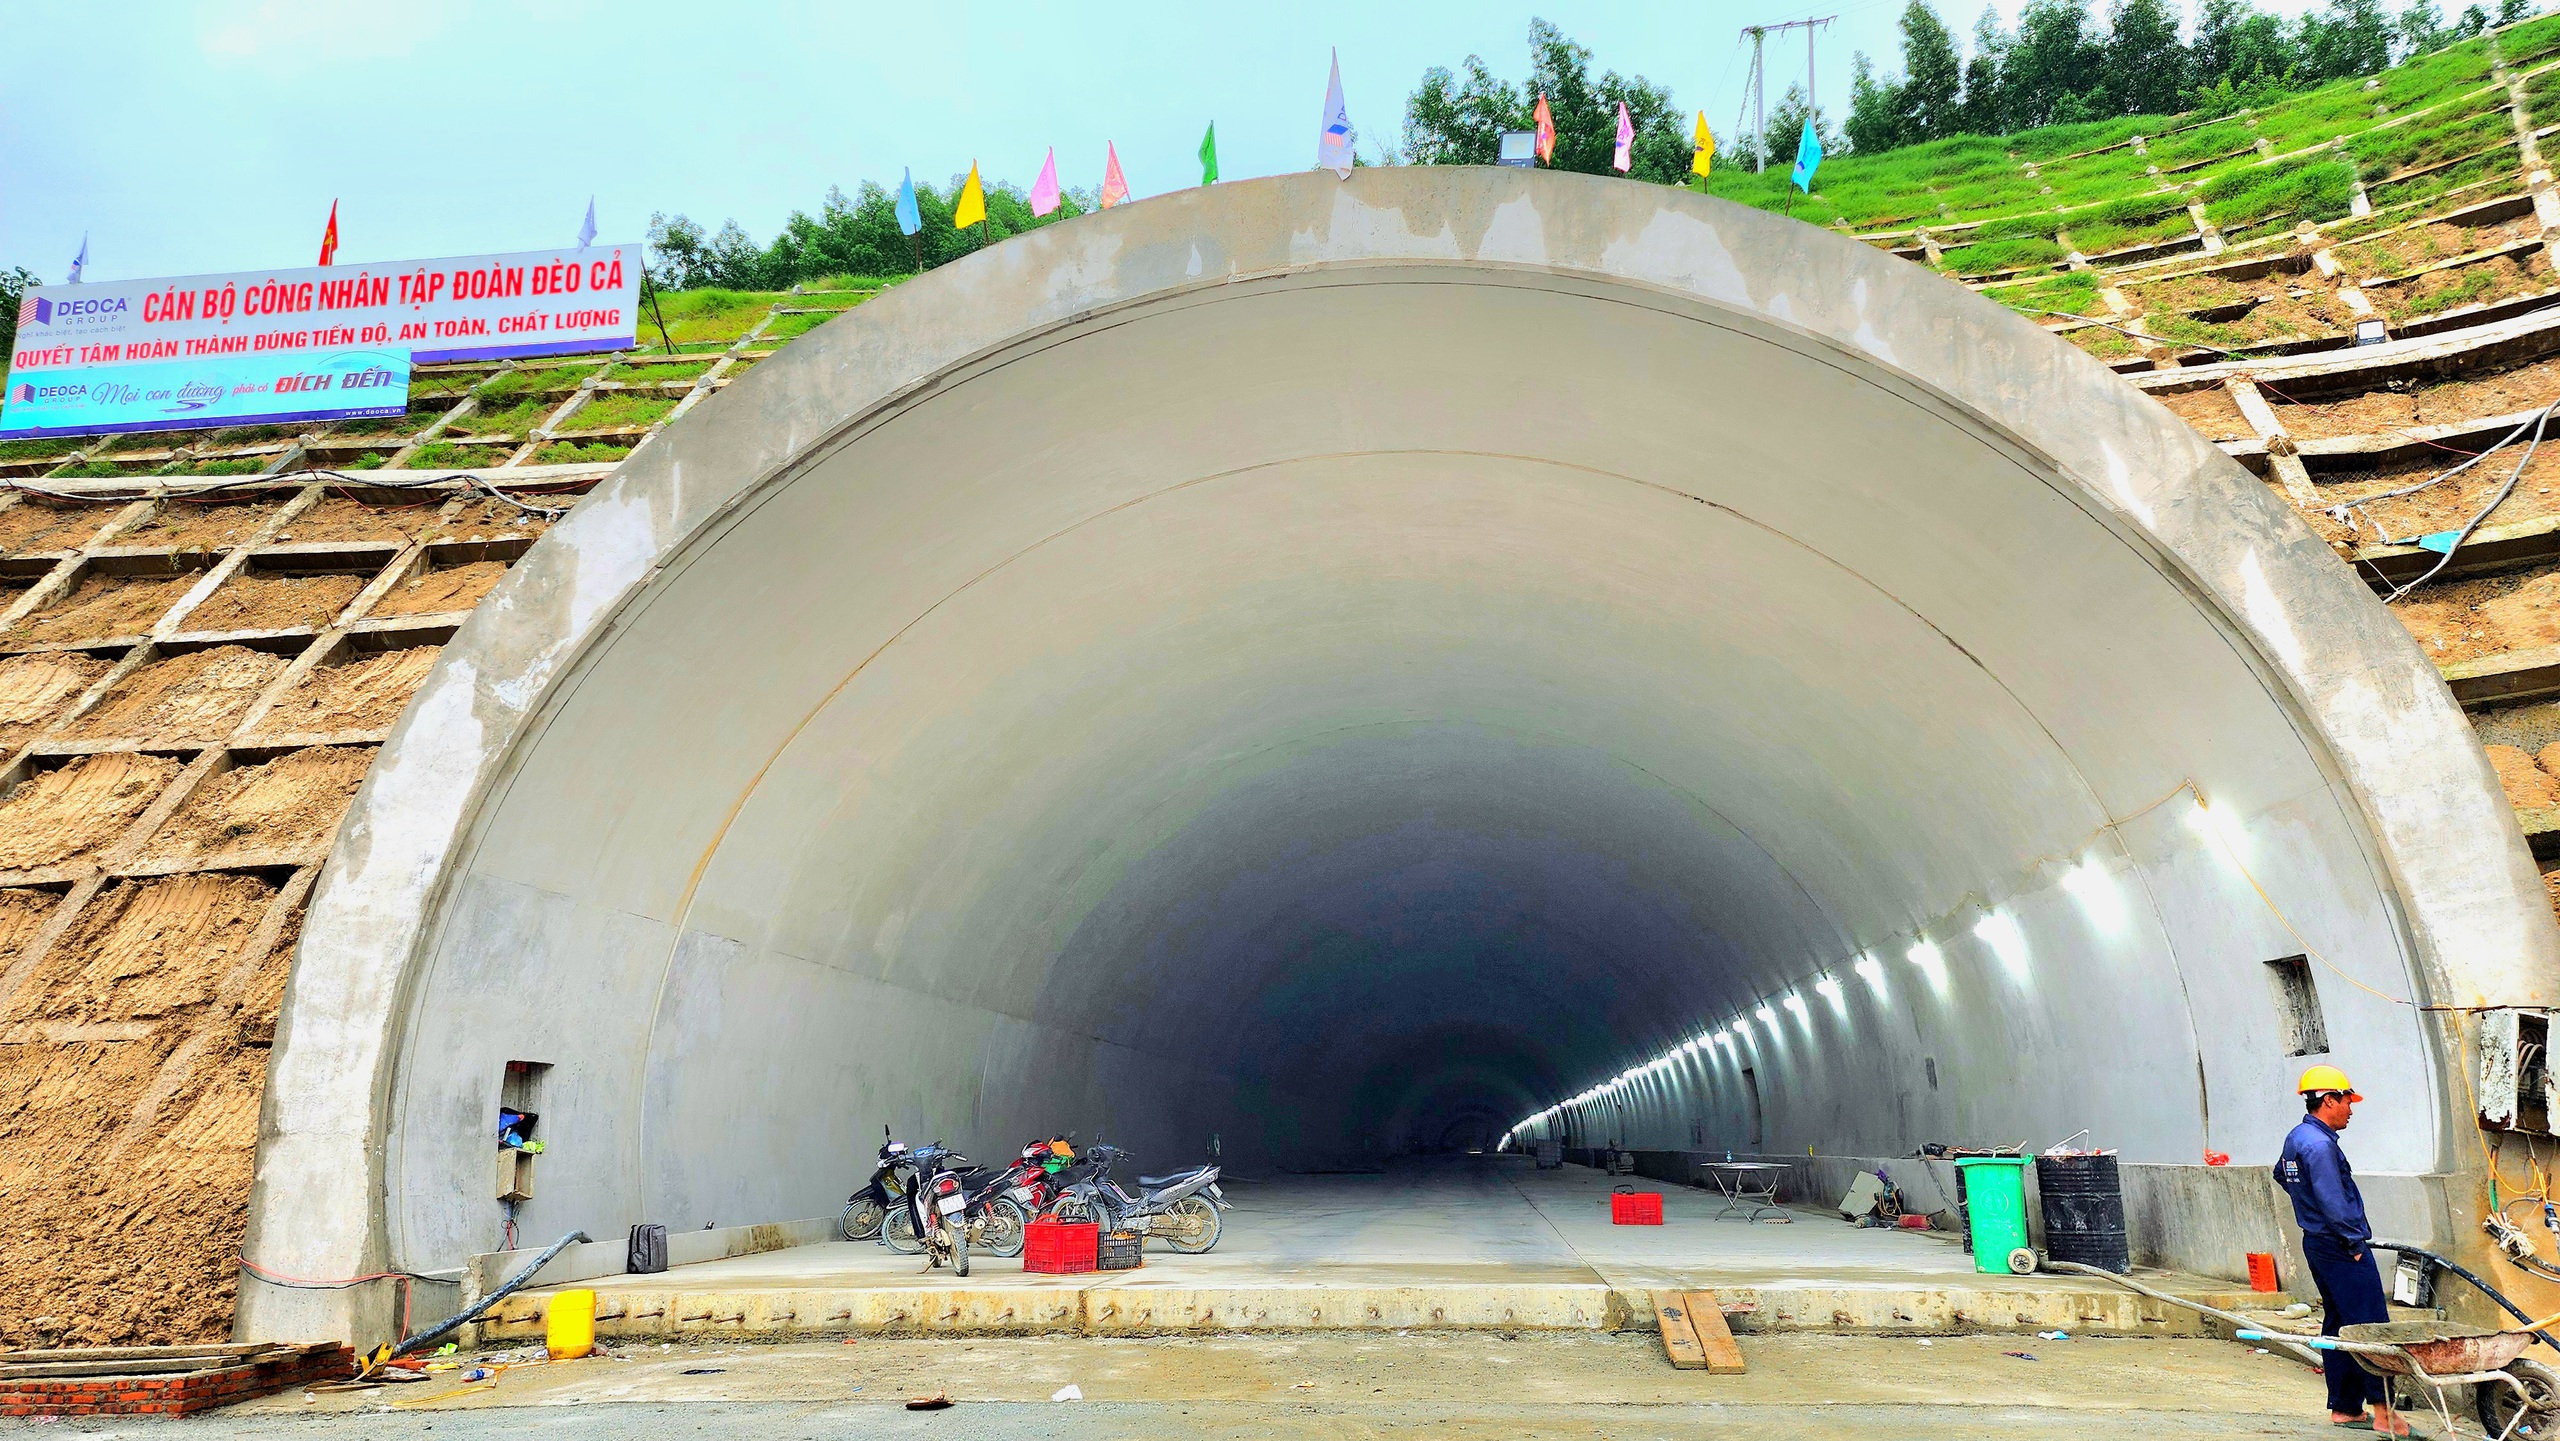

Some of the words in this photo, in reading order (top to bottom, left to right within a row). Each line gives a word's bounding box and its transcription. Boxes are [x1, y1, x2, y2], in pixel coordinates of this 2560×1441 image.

[143, 285, 196, 323] CÁN
[201, 281, 236, 325] BỘ
[243, 278, 313, 317] CÔNG
[318, 271, 390, 311] NHÂN
[398, 267, 445, 310] TẬP
[453, 262, 524, 301] ĐOÀN
[532, 258, 581, 296] ĐÈO
[589, 249, 623, 292] CẢ
[57, 297, 128, 317] DEOCA
[65, 314, 118, 326] GROUP
[15, 343, 74, 369] QUYẾT
[80, 342, 120, 364] TÂM
[125, 338, 179, 361] HOÀN
[185, 334, 248, 356] THÀNH
[253, 330, 308, 351] ĐÚNG
[312, 323, 355, 347] TIẾN
[360, 321, 392, 346] ĐỘ,
[399, 322, 427, 341] AN
[434, 316, 491, 337] TOÀN,
[498, 309, 549, 334] CHẤT
[555, 309, 620, 331] LƯỢNG
[39, 384, 87, 397] DEOCA
[145, 389, 172, 400] con
[176, 381, 226, 404] đường
[274, 371, 333, 394] ĐÍCH
[44, 396, 81, 404] GROUP
[345, 408, 402, 416] www.deoca.vn
